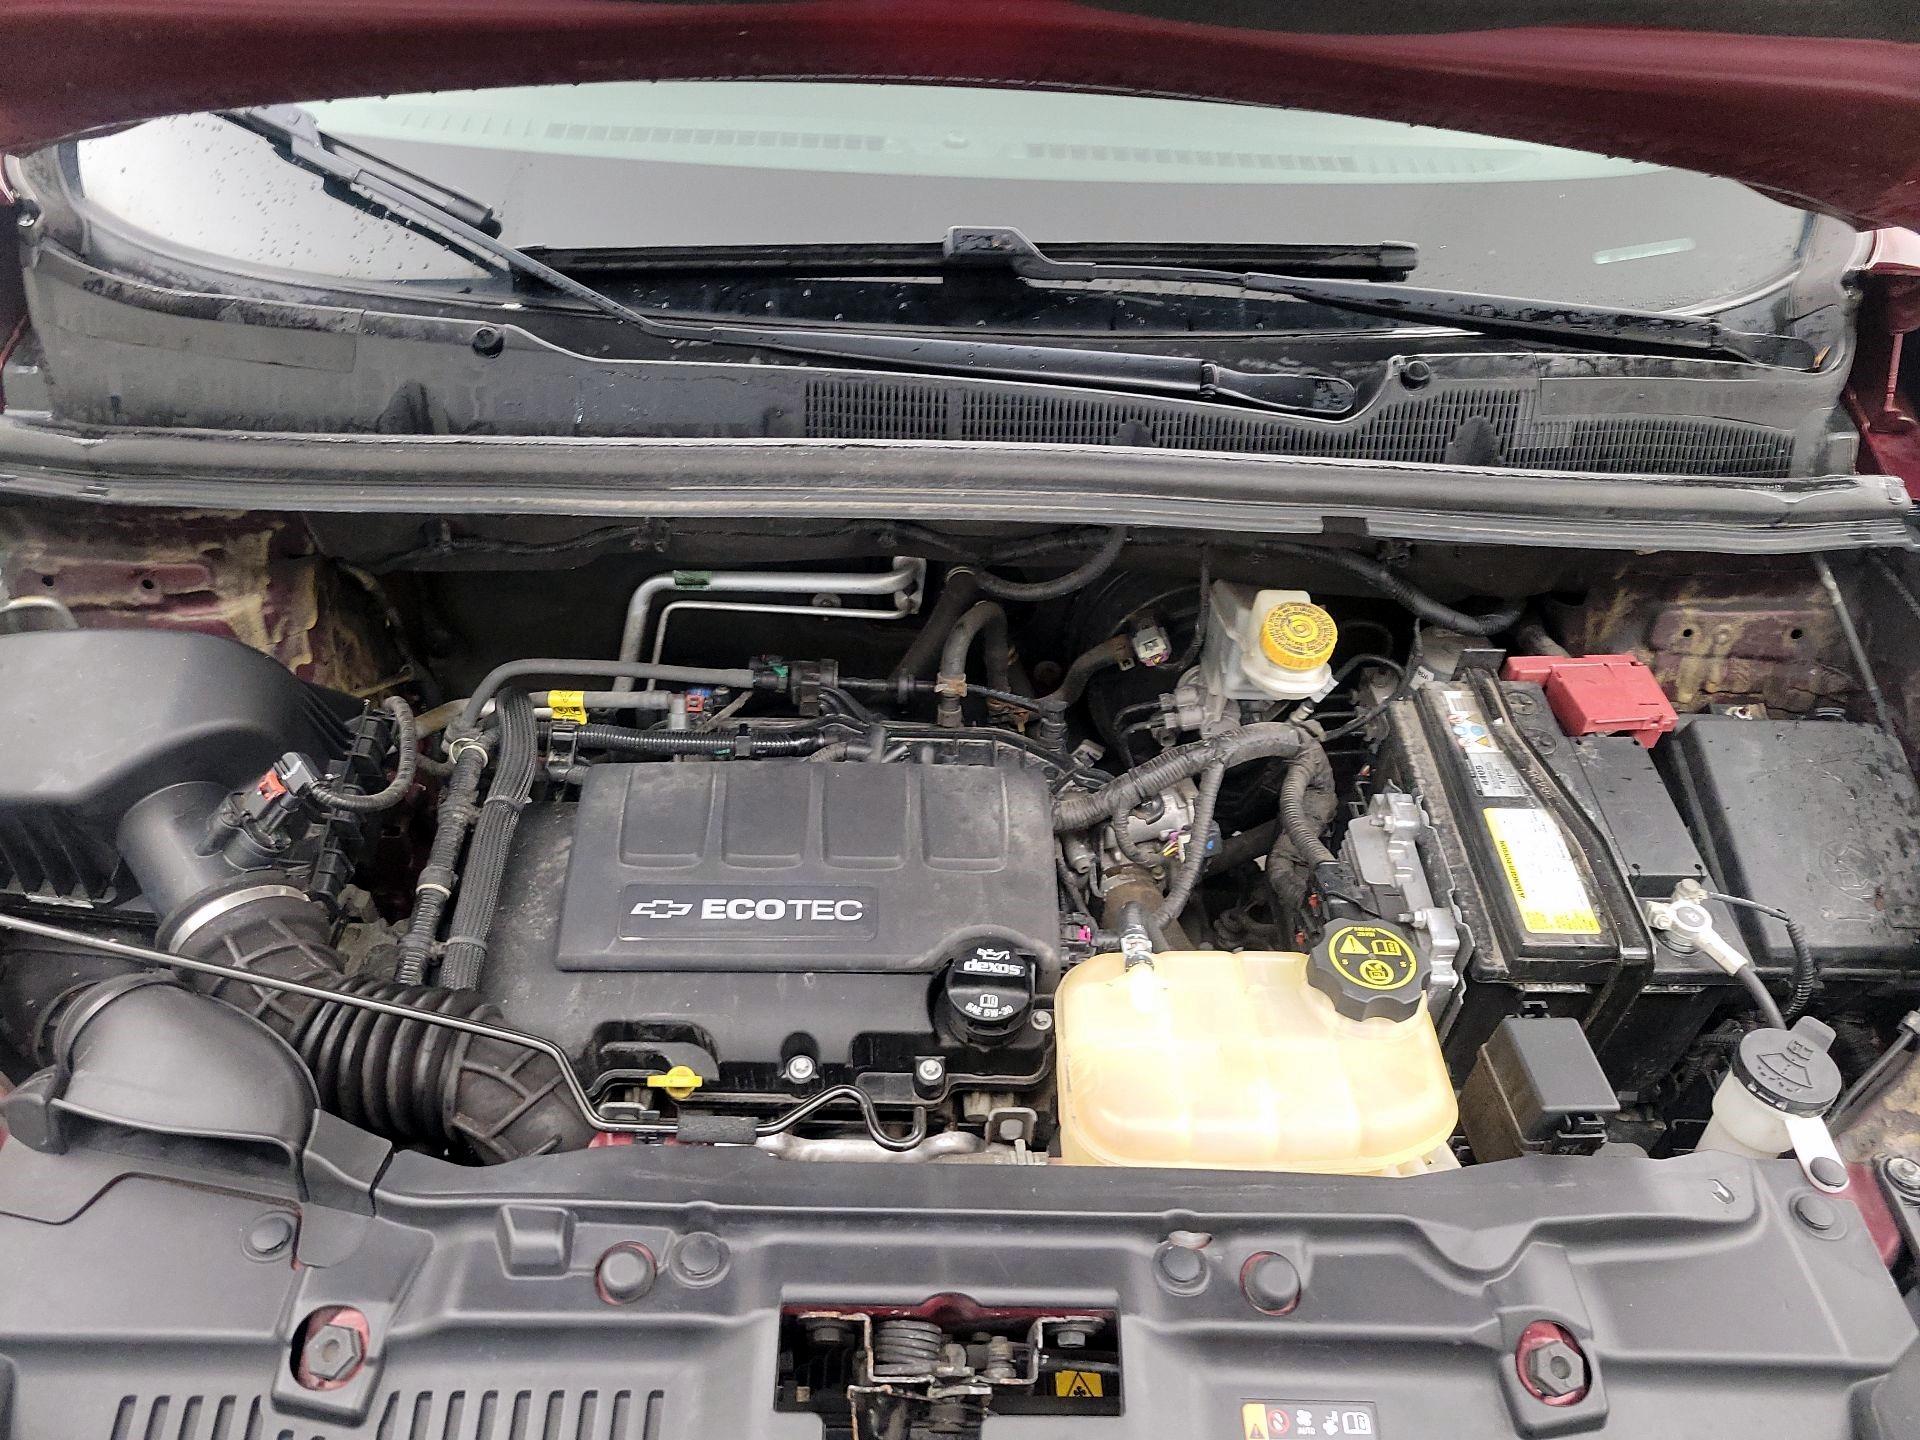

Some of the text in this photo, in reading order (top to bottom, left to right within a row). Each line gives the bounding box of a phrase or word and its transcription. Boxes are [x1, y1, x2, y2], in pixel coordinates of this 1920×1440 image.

[701, 898, 863, 921] ECOTEC
[963, 958, 1022, 976] dexos
[965, 1001, 983, 1016] SAE
